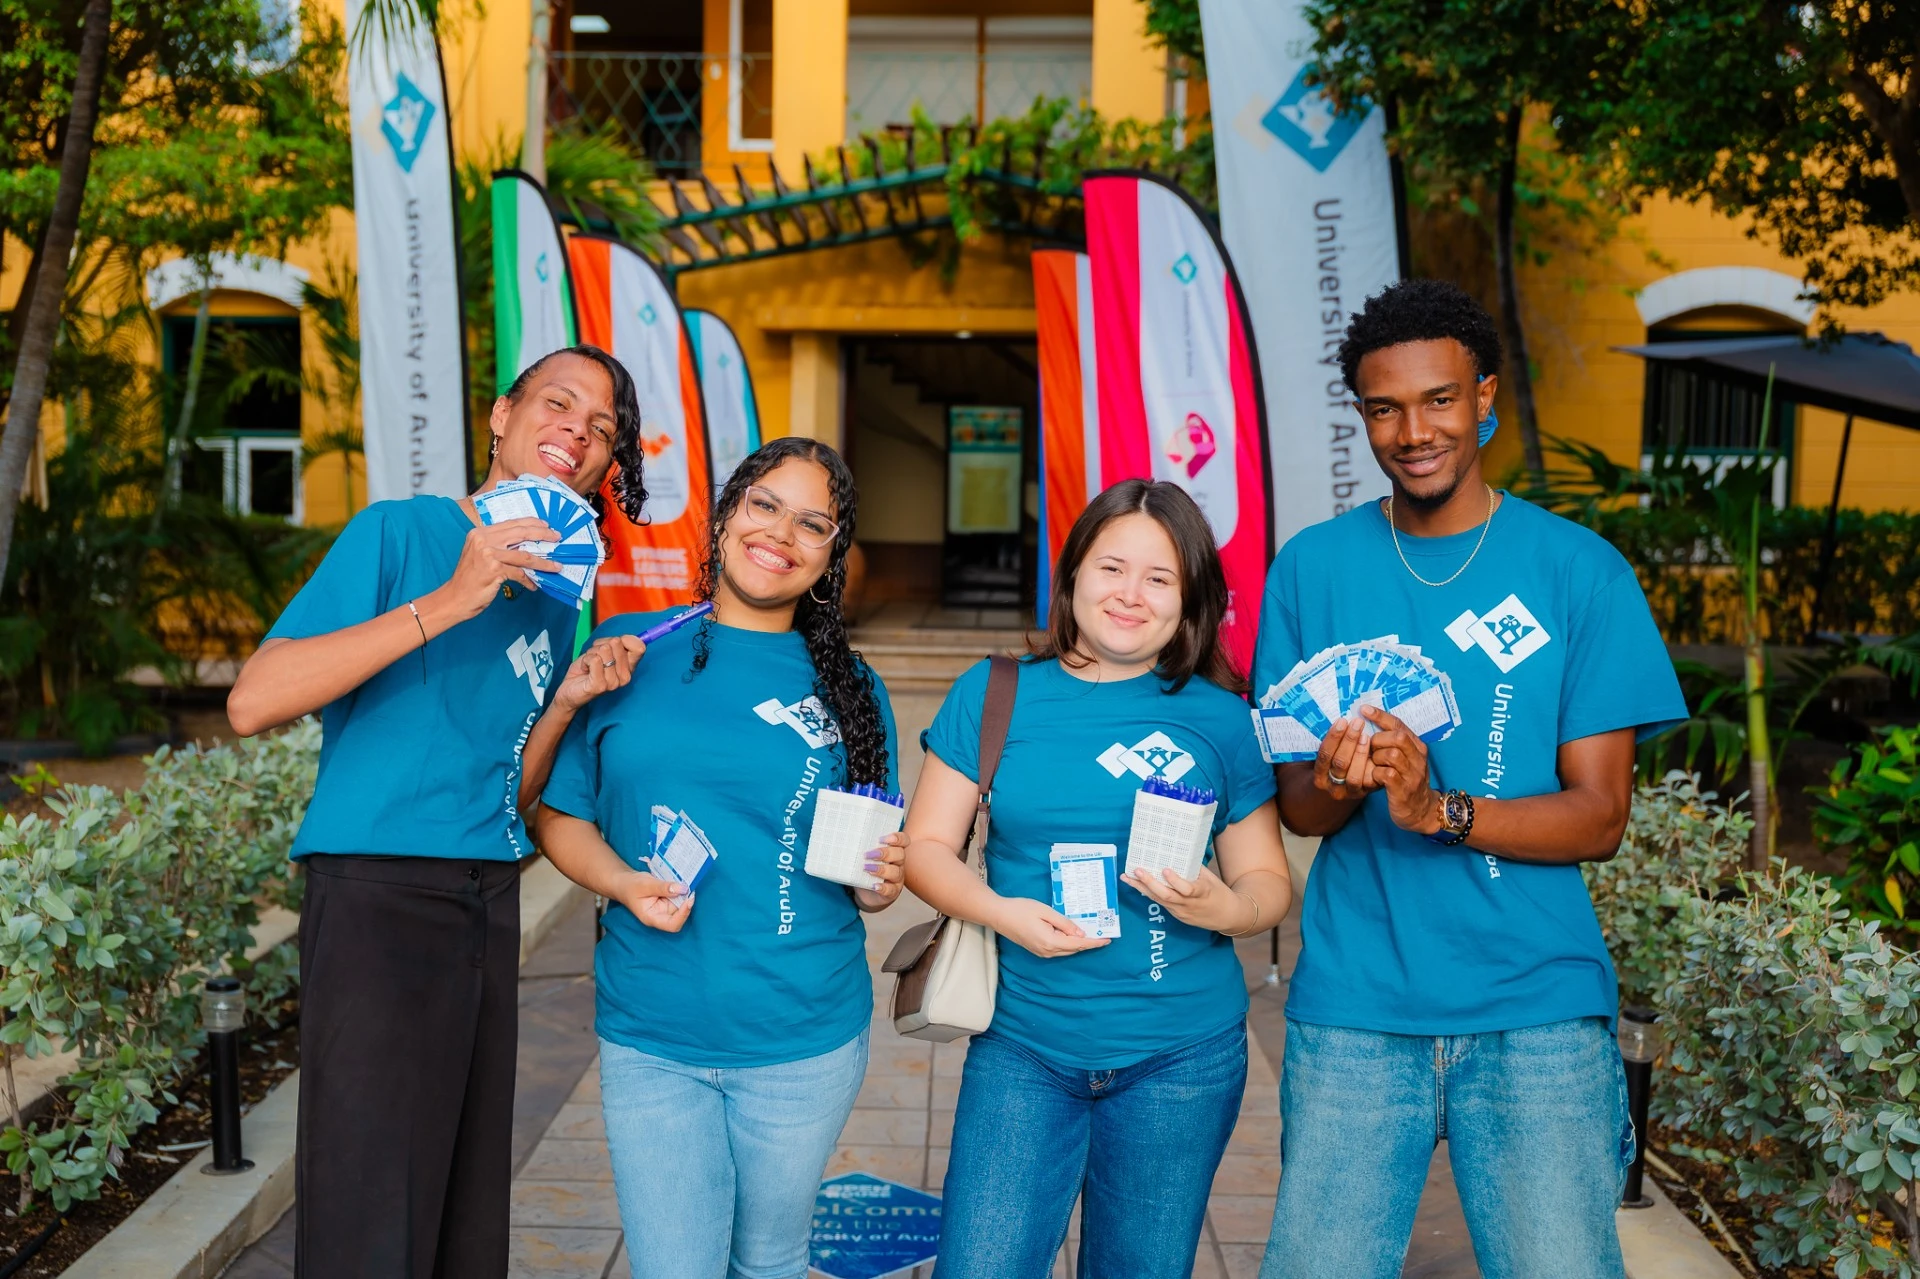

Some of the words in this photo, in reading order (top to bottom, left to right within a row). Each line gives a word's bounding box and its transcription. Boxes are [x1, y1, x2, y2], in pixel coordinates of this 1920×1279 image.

[404, 198, 428, 362] University
[1313, 199, 1346, 367] University
[409, 373, 431, 401] of
[1325, 379, 1349, 412] of
[1481, 683, 1514, 789] University
[777, 756, 822, 852] University
[777, 852, 795, 873] of
[777, 875, 796, 936] Aruba
[1148, 903, 1166, 924] of
[814, 1203, 941, 1216] elcom
[812, 1232, 863, 1243] rsity
[869, 1233, 891, 1241] of
[897, 1233, 940, 1242] Aru
